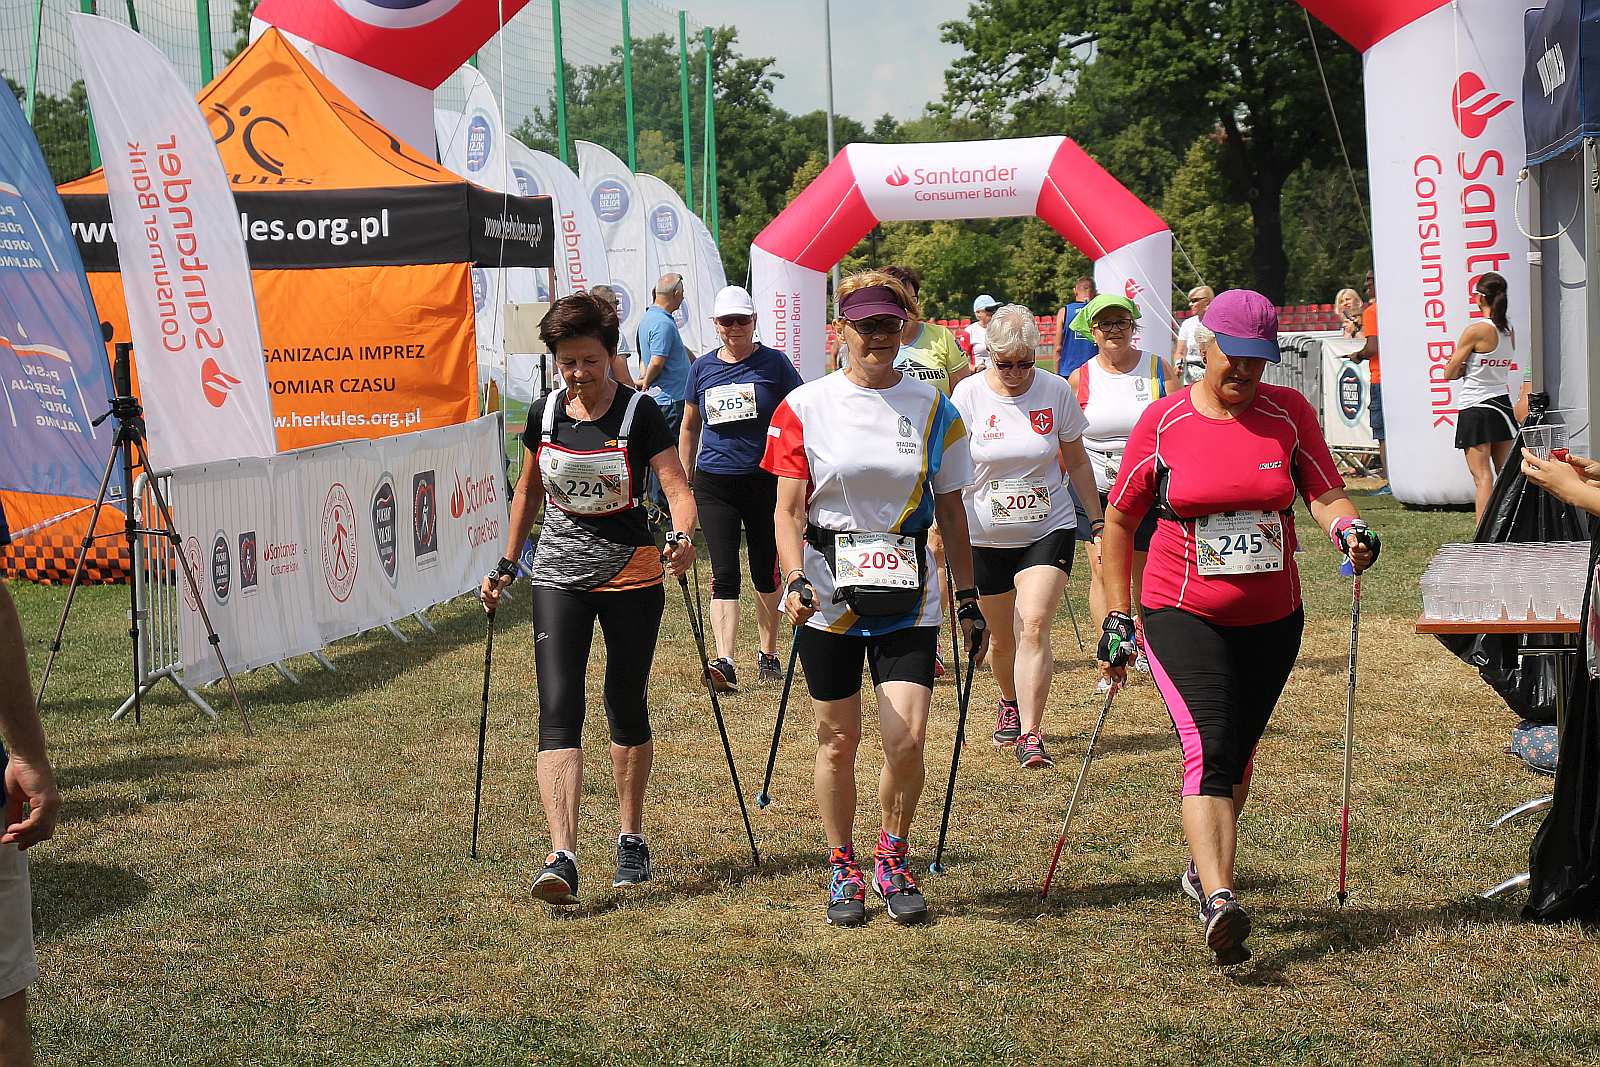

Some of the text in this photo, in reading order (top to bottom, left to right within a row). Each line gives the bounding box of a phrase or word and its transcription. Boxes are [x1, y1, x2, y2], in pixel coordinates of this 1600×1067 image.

[914, 165, 1018, 185] Santander
[914, 187, 1017, 201] Consumer Bank
[1414, 154, 1460, 428] Consumer Bank
[791, 292, 801, 321] Bank
[773, 291, 787, 352] tander
[359, 344, 425, 360] IMPREZ
[339, 377, 396, 393] CZASU
[718, 397, 743, 411] 265
[896, 441, 917, 449] STADION
[566, 480, 605, 498] 224
[1006, 494, 1038, 510] 202
[1218, 533, 1263, 556] 245
[858, 551, 899, 570] 209
